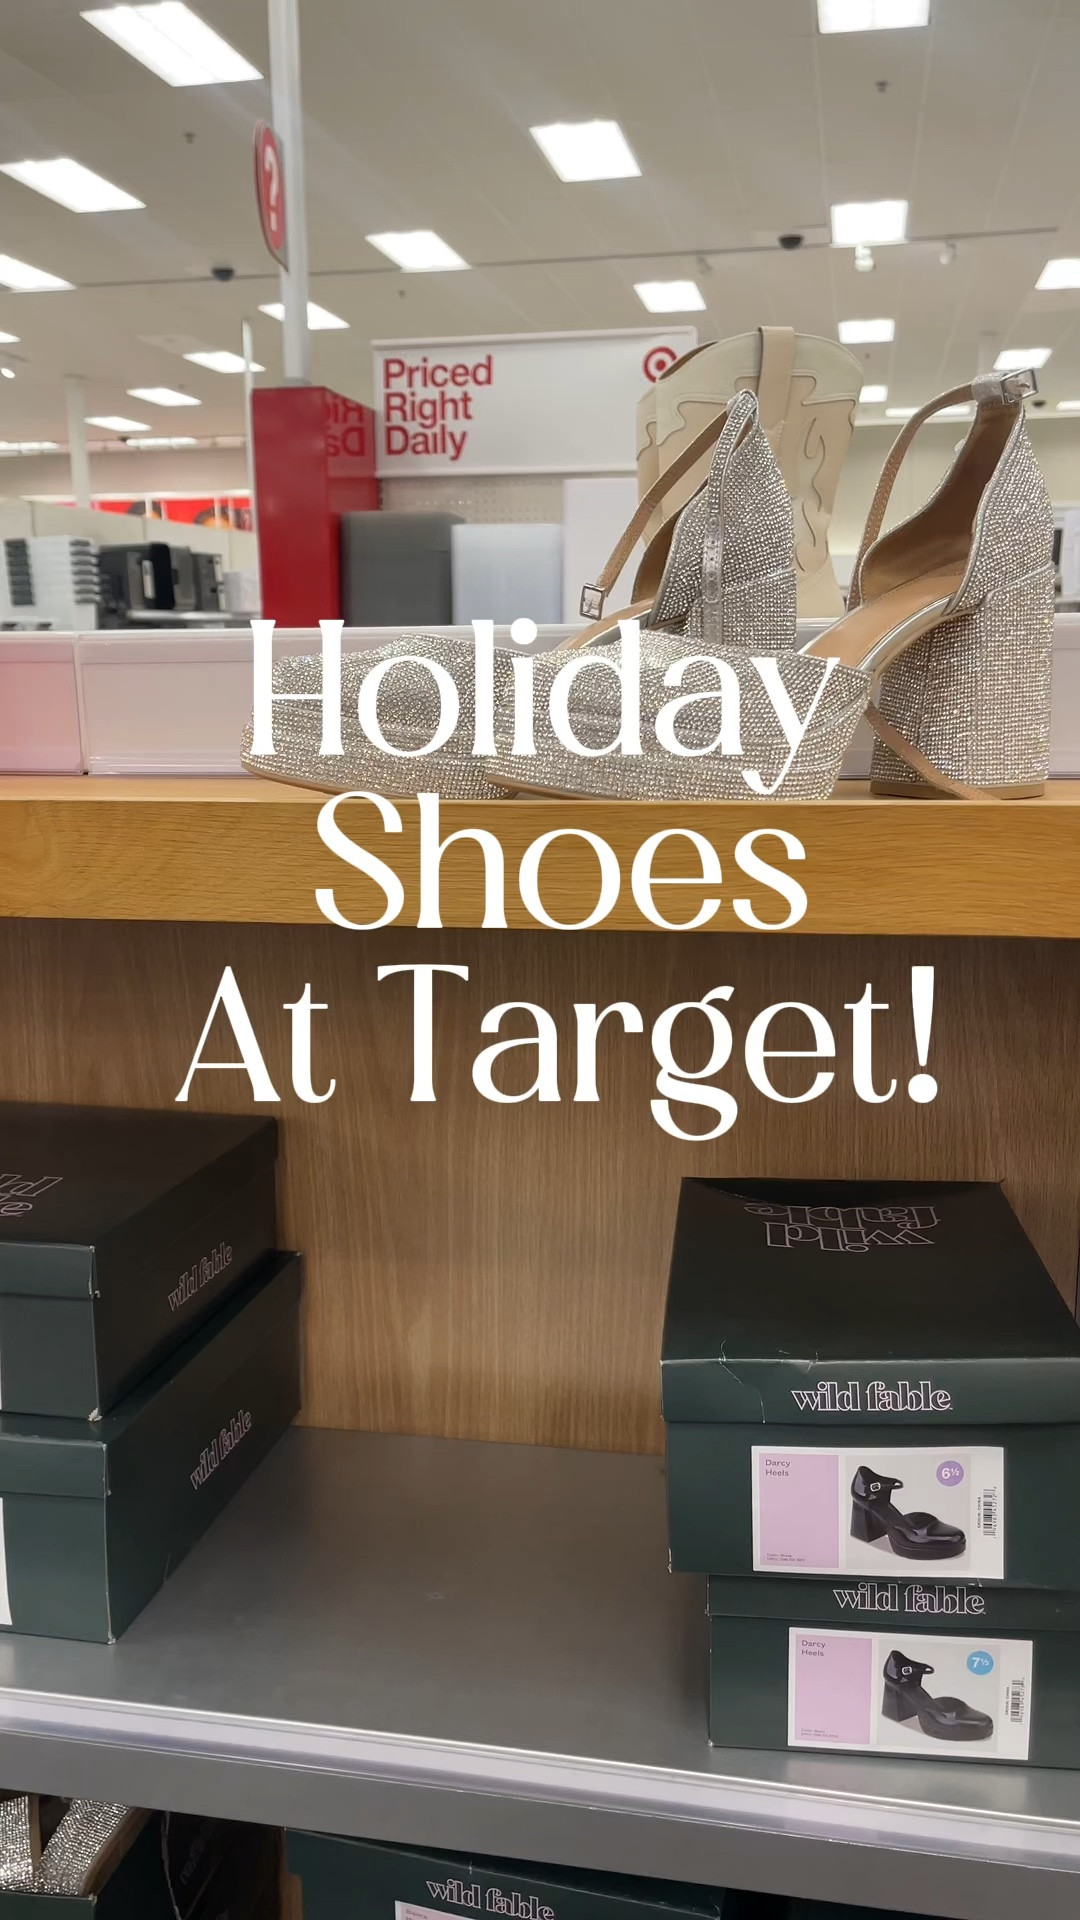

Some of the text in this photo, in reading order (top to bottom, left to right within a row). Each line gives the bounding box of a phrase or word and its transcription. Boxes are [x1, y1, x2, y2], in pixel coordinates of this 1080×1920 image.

[383, 354, 493, 389] Priced
[384, 390, 474, 429] Right
[385, 423, 468, 462] Daily
[744, 1202, 941, 1230] fable
[764, 1222, 936, 1253] wild
[167, 1241, 233, 1312] wild fable
[790, 1381, 952, 1412] wild fable
[189, 1408, 252, 1490] wild fable
[765, 1459, 791, 1468] Darcy
[765, 1469, 789, 1477] Heels
[832, 1582, 985, 1615] wild fable
[801, 1639, 826, 1649] Darcy
[801, 1649, 825, 1657] Heels
[425, 1878, 555, 1920] wild fable
